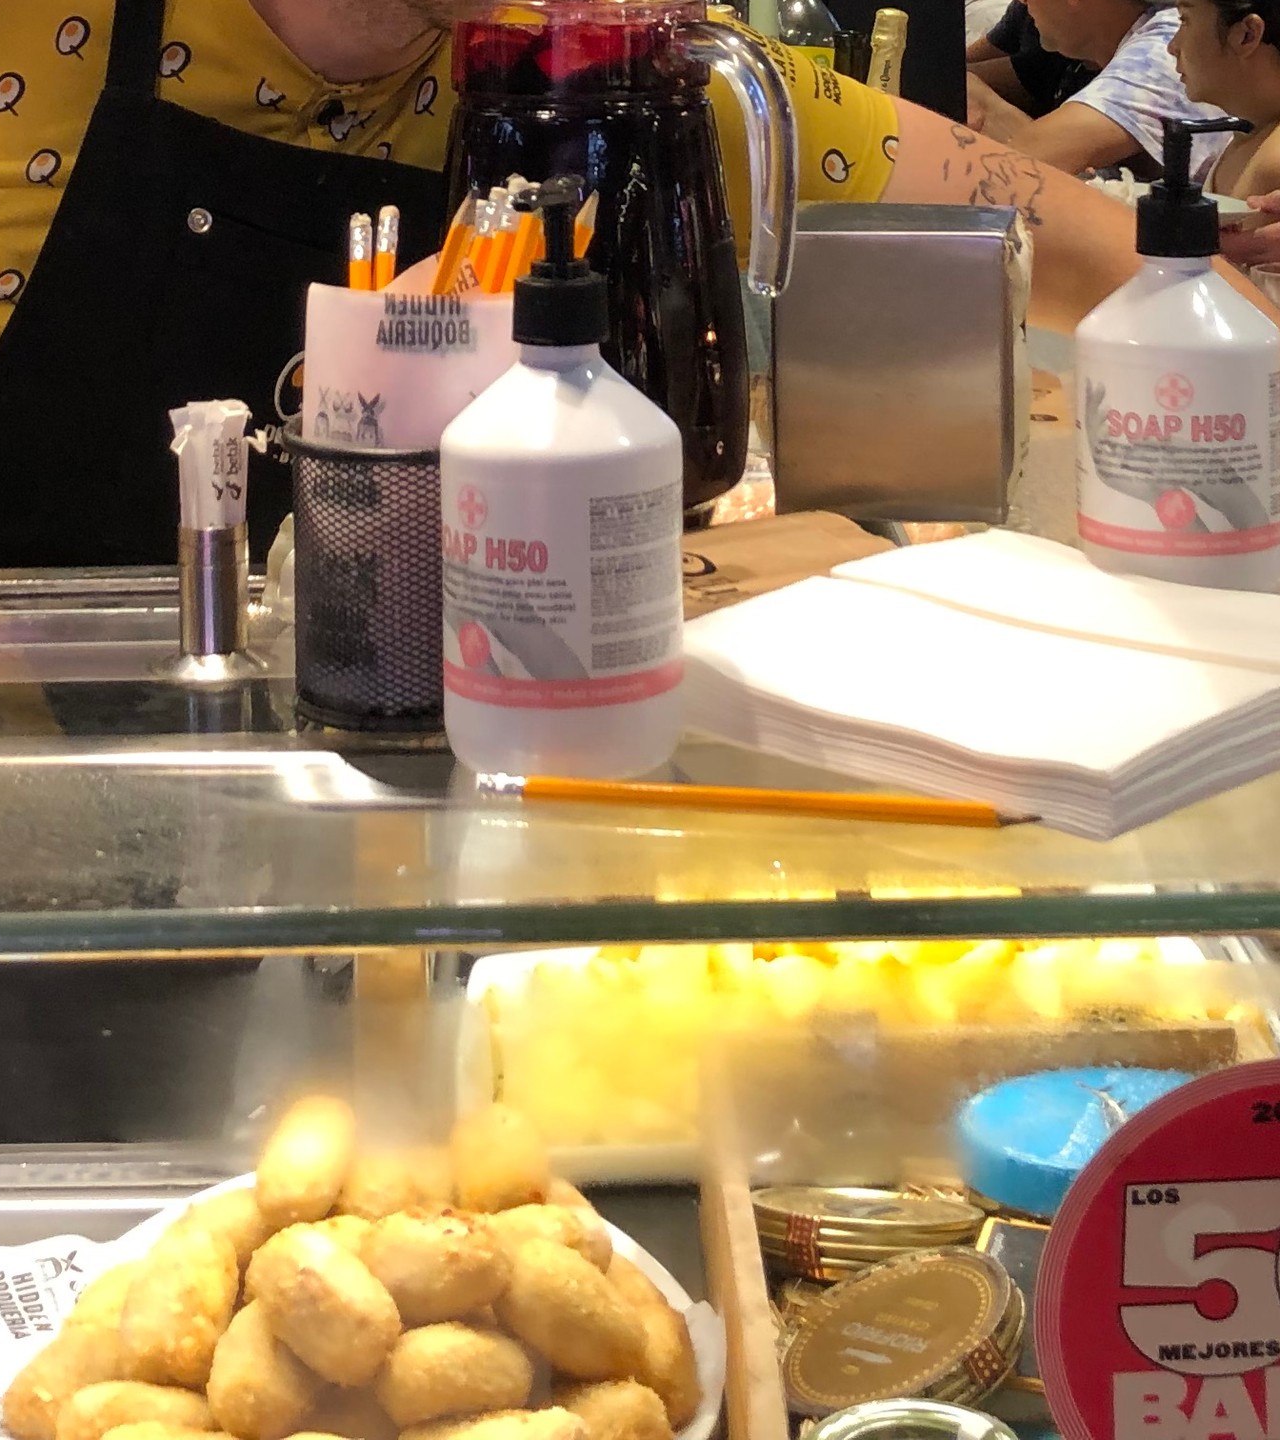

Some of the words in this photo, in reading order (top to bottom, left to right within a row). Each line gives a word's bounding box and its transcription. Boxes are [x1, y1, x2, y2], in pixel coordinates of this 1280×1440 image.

[1106, 408, 1183, 443] SOAP
[1190, 412, 1247, 443] H50
[443, 525, 478, 565] OAP
[485, 536, 549, 573] H50
[1131, 1188, 1181, 1206] LOS
[11, 1271, 55, 1332] HIDDEN
[1159, 1340, 1280, 1361] MEJORES
